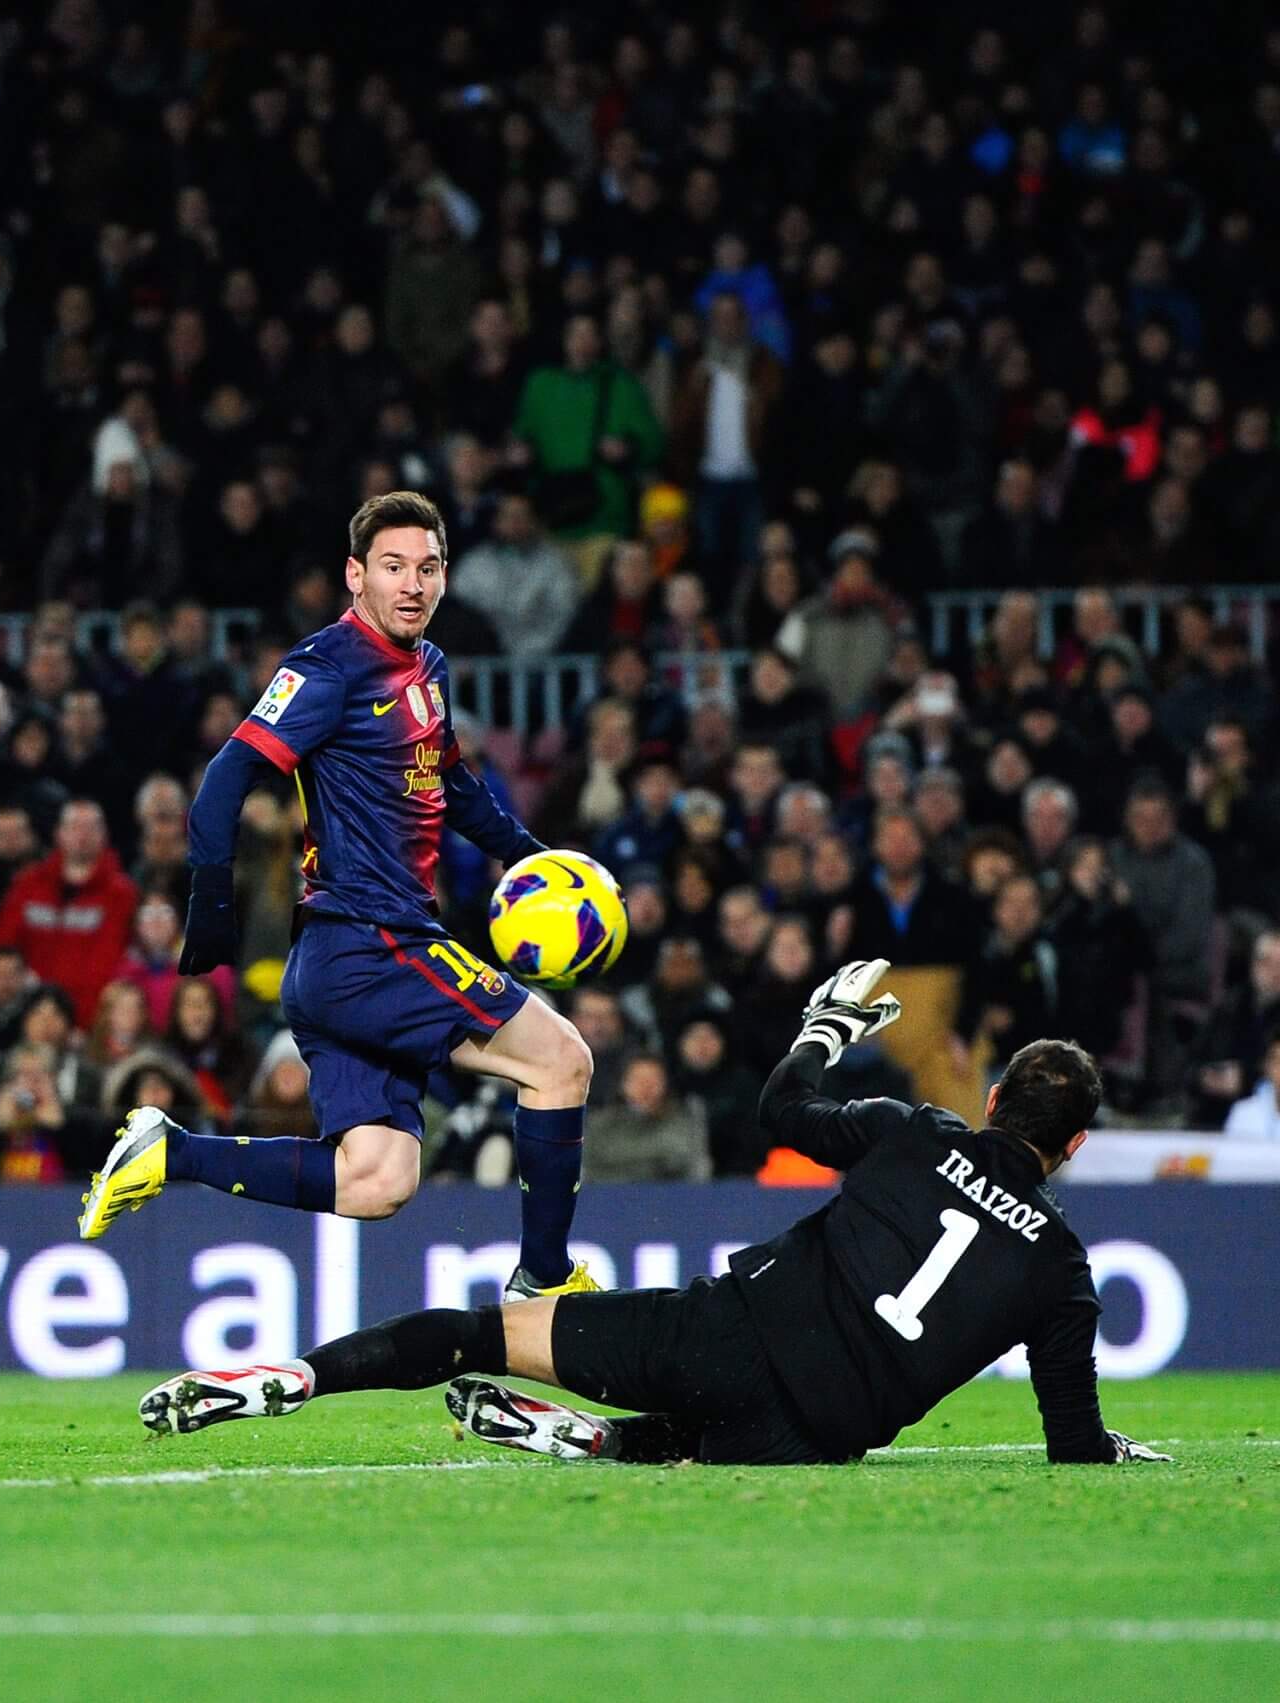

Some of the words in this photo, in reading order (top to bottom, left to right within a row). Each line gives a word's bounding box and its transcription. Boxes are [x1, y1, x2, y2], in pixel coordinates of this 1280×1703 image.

[936, 1149, 1048, 1242] IRAIZOZ
[181, 1213, 361, 1371] al
[875, 1208, 980, 1341] 1
